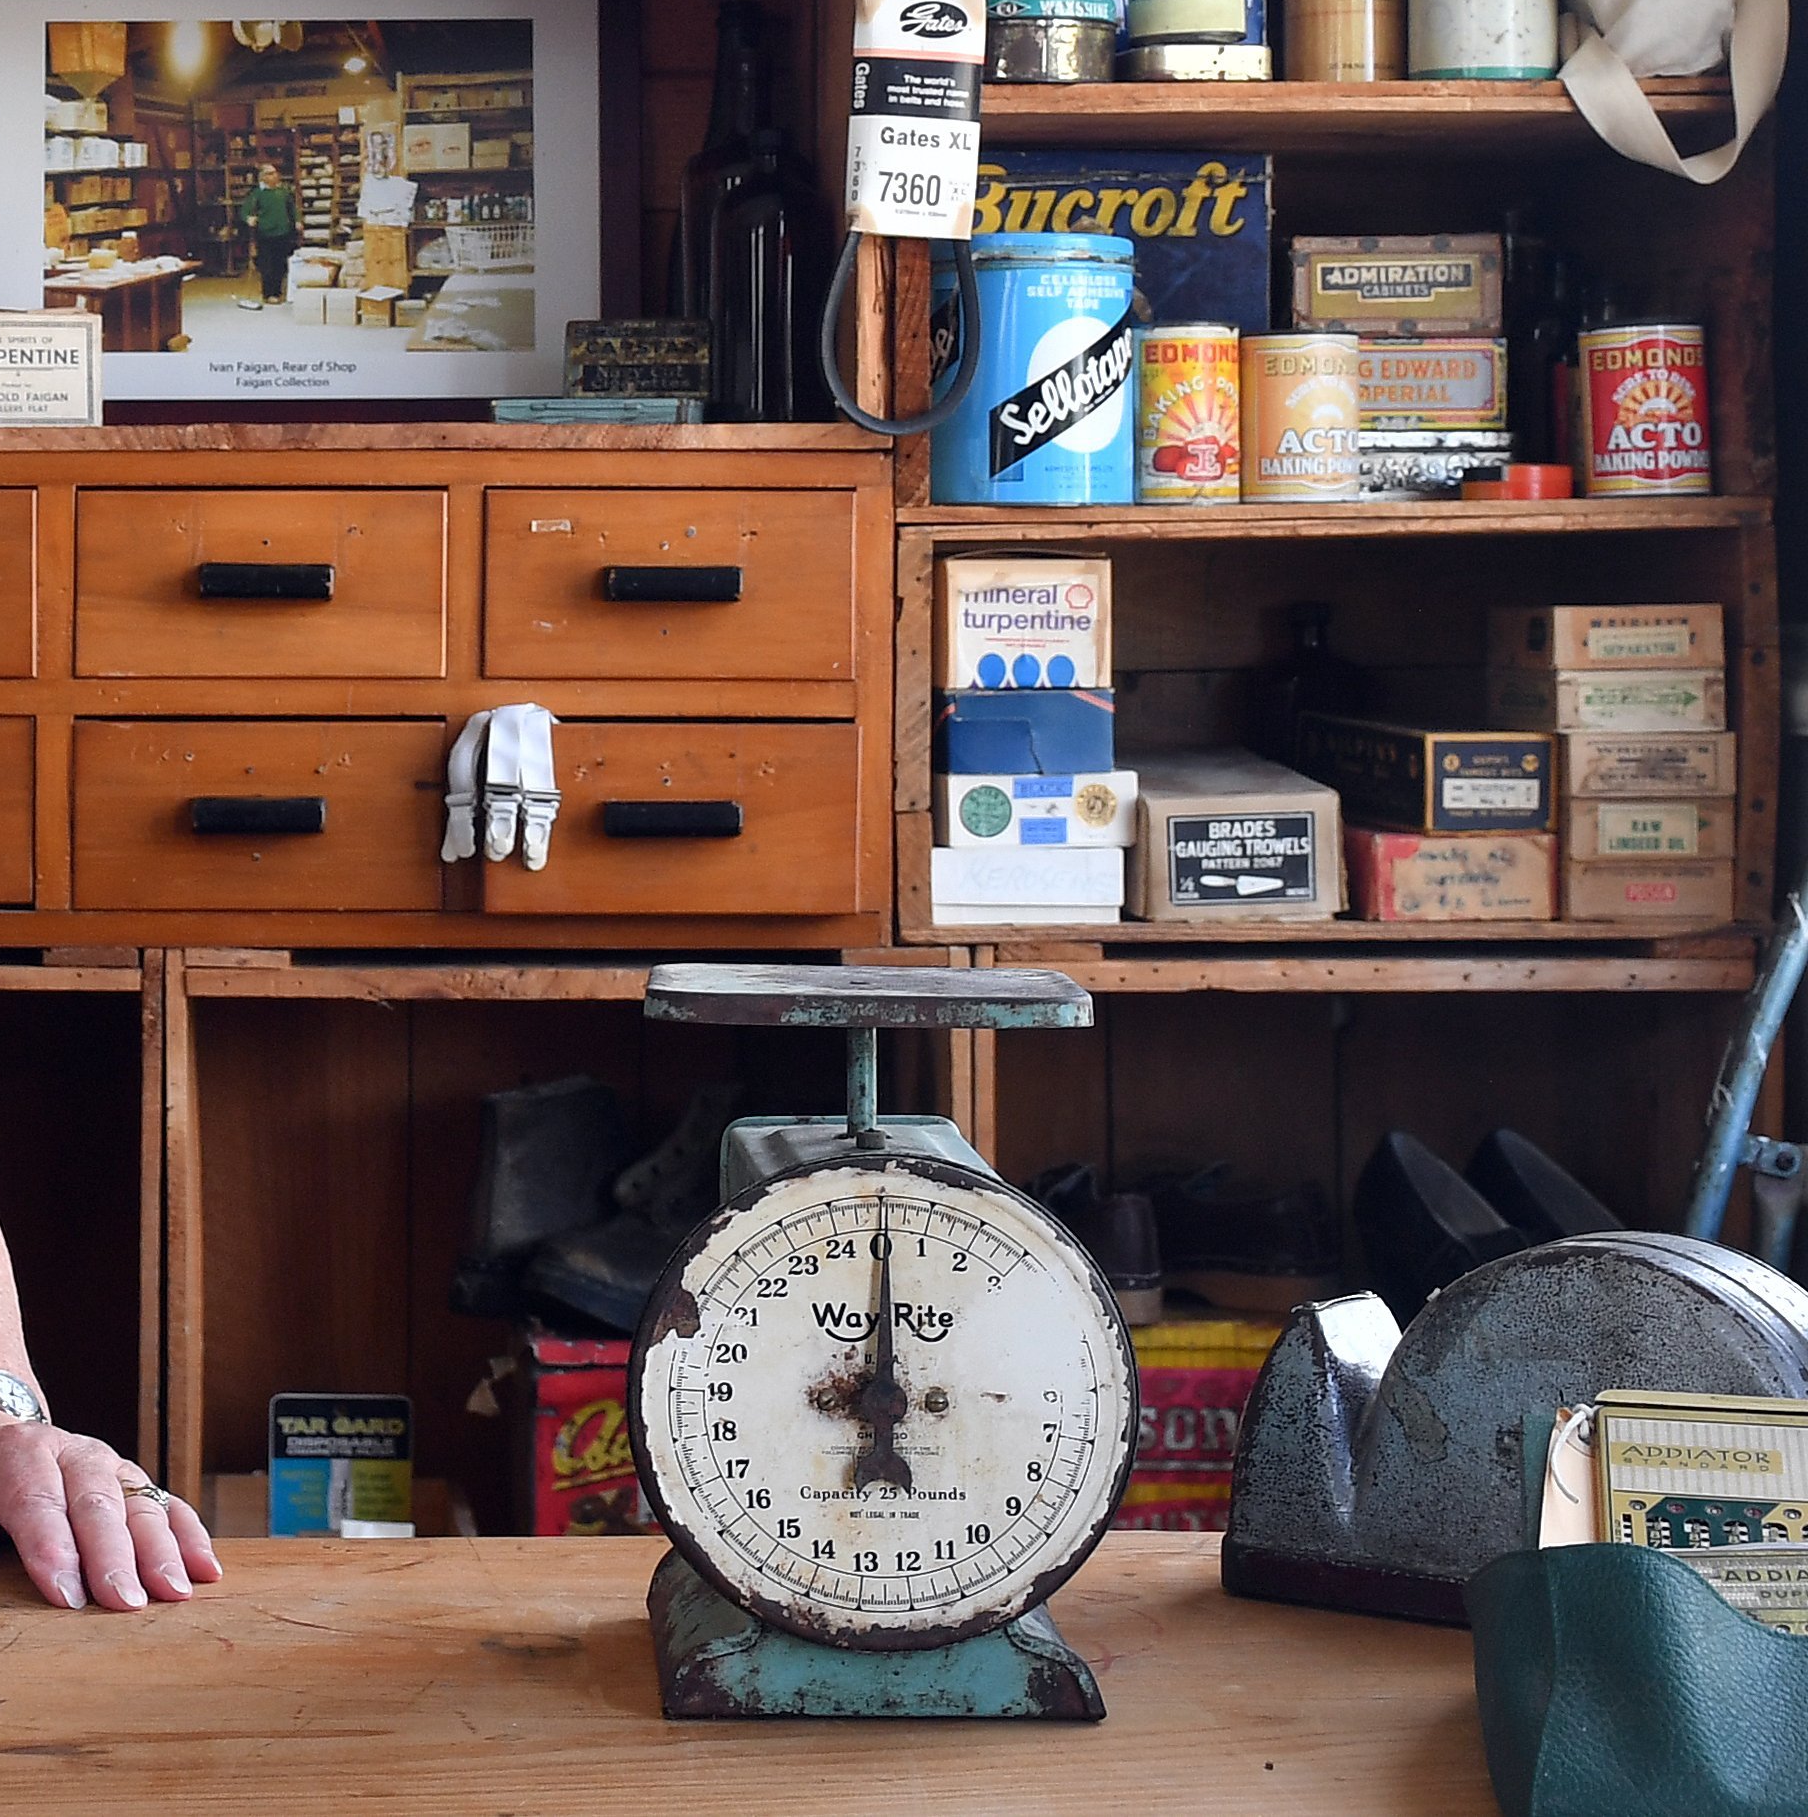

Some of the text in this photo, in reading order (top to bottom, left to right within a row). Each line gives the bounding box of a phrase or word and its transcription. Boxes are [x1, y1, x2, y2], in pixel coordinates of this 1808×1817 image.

[900, 2, 966, 34] Gates
[853, 62, 871, 110] Gates
[903, 74, 956, 88] The world's
[887, 85, 970, 99] most trusted name
[888, 94, 899, 104] in
[899, 94, 923, 106] belts
[924, 96, 942, 107] and
[880, 126, 972, 151] Gates XL
[877, 170, 941, 207] 7360
[1325, 264, 1466, 285] ADMIRATION
[1362, 284, 1430, 298] CABINETS
[7, 336, 37, 344] SPIRITS
[41, 336, 53, 344] OF
[208, 361, 357, 375] Ivan Faigan, Rear of Shop
[1380, 359, 1478, 380] EDWARD
[236, 376, 330, 389] Faigan Collection
[25, 392, 69, 403] FAIGAN
[1358, 385, 1453, 403] MPERIAL
[27, 404, 49, 413] FLAT
[1607, 421, 1703, 451] ACTO
[1261, 456, 1324, 476] BAKING
[1595, 450, 1655, 472] BAKING
[964, 584, 1059, 606] mineral
[962, 607, 1092, 635] turpentine
[1208, 820, 1277, 839] BRADES
[1176, 837, 1310, 858] GAUGING TROWELS
[1201, 857, 1251, 870] PATTERN
[788, 1255, 820, 1276] 23
[824, 1239, 857, 1260] 24
[914, 1237, 928, 1258] 1
[951, 1252, 969, 1273] 2
[756, 1278, 789, 1299] 22
[811, 1301, 954, 1337] Way Rite
[714, 1343, 749, 1364] 20
[706, 1381, 734, 1403] 19
[276, 1415, 329, 1435] TAR
[710, 1421, 738, 1442] 18
[1041, 1423, 1059, 1444] 7
[1621, 1445, 1771, 1465] ADDIATOR
[1622, 1457, 1770, 1472] STANDARD
[725, 1459, 751, 1480] 17
[1026, 1462, 1044, 1483] 8
[745, 1489, 772, 1510] 16
[799, 1485, 967, 1505] Capacity 25 Pounds
[849, 1510, 863, 1520] NOT
[865, 1510, 886, 1520] LEGAL
[1004, 1496, 1023, 1517] 9
[776, 1519, 802, 1539] 15
[964, 1524, 992, 1545] 10
[810, 1540, 837, 1561] 14
[934, 1541, 957, 1561] 11
[852, 1552, 880, 1573] 13
[894, 1551, 924, 1572] 12
